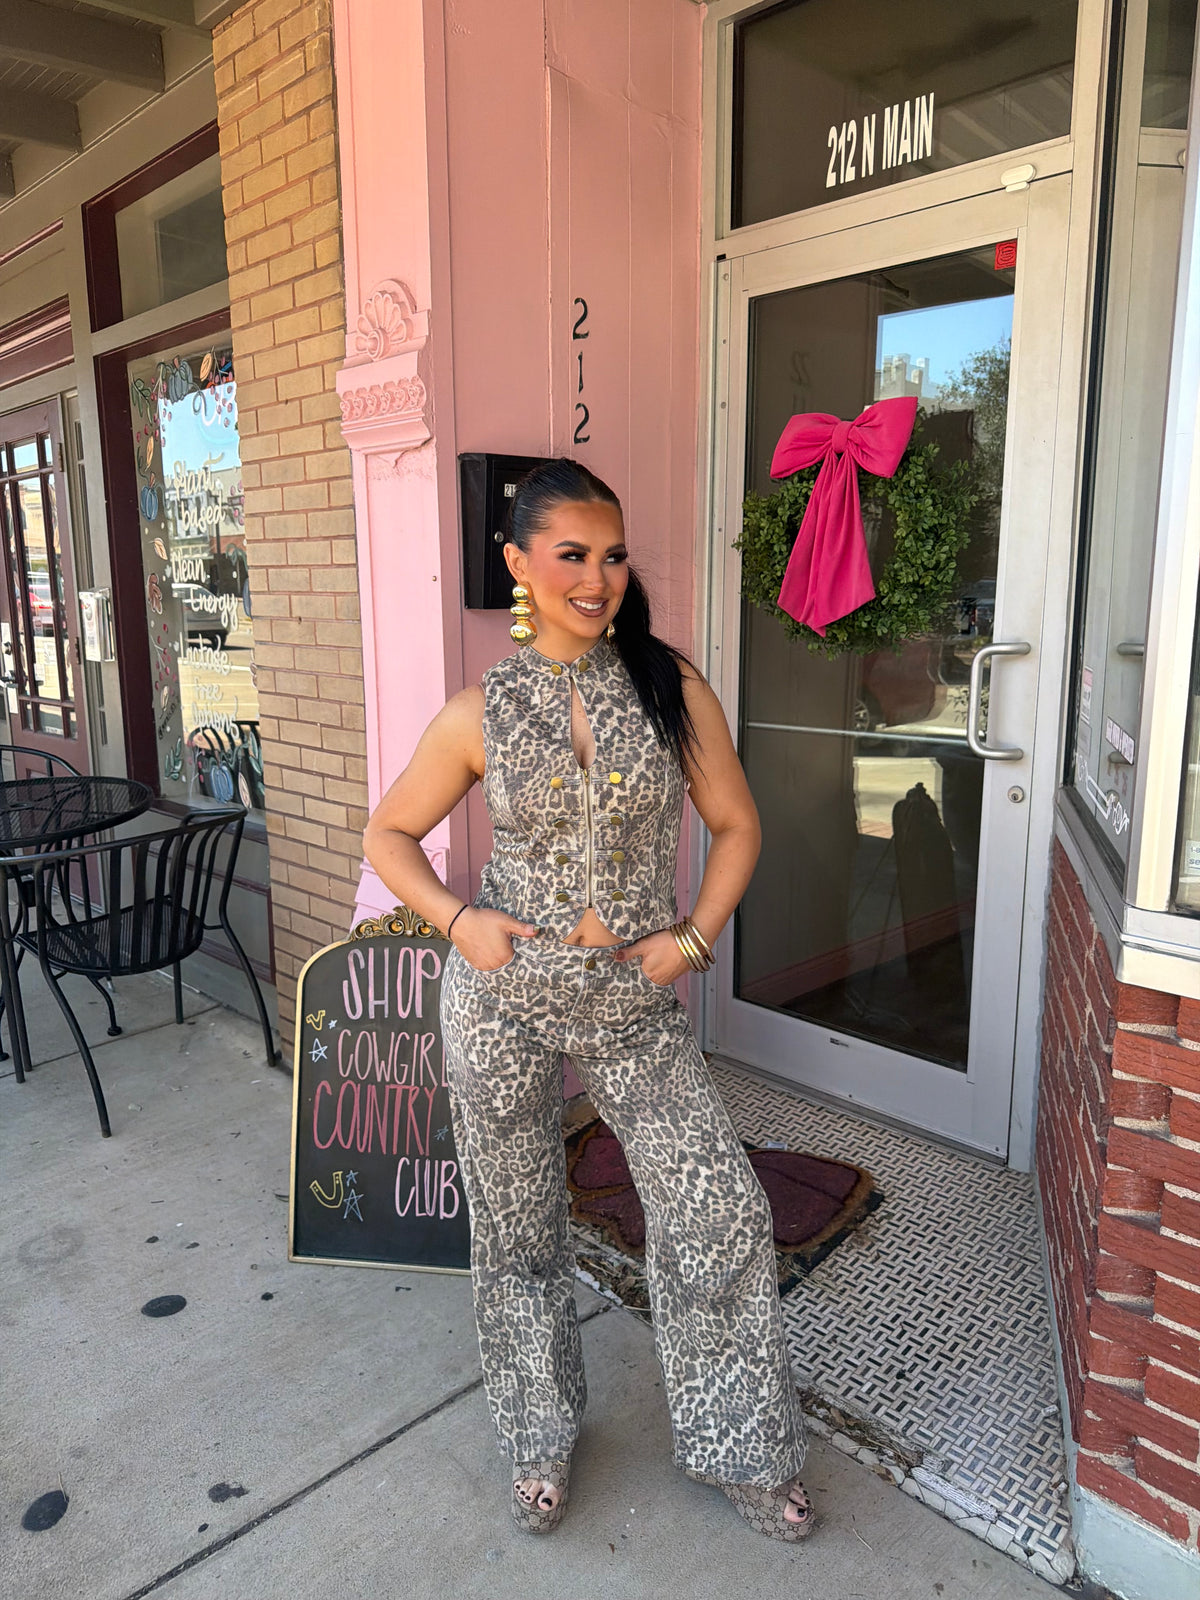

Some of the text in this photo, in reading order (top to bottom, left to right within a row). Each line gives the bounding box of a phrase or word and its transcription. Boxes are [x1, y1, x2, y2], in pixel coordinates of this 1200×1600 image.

[826, 92, 934, 188] 212 N MAIN
[173, 451, 224, 501] Plant
[181, 489, 226, 533] based
[171, 550, 206, 583] Clean
[190, 585, 238, 632] Energy
[179, 632, 232, 676] Lactose
[343, 946, 441, 1020] SHOP
[313, 1080, 438, 1157] COUNTRY
[395, 1157, 460, 1220] CLUB
